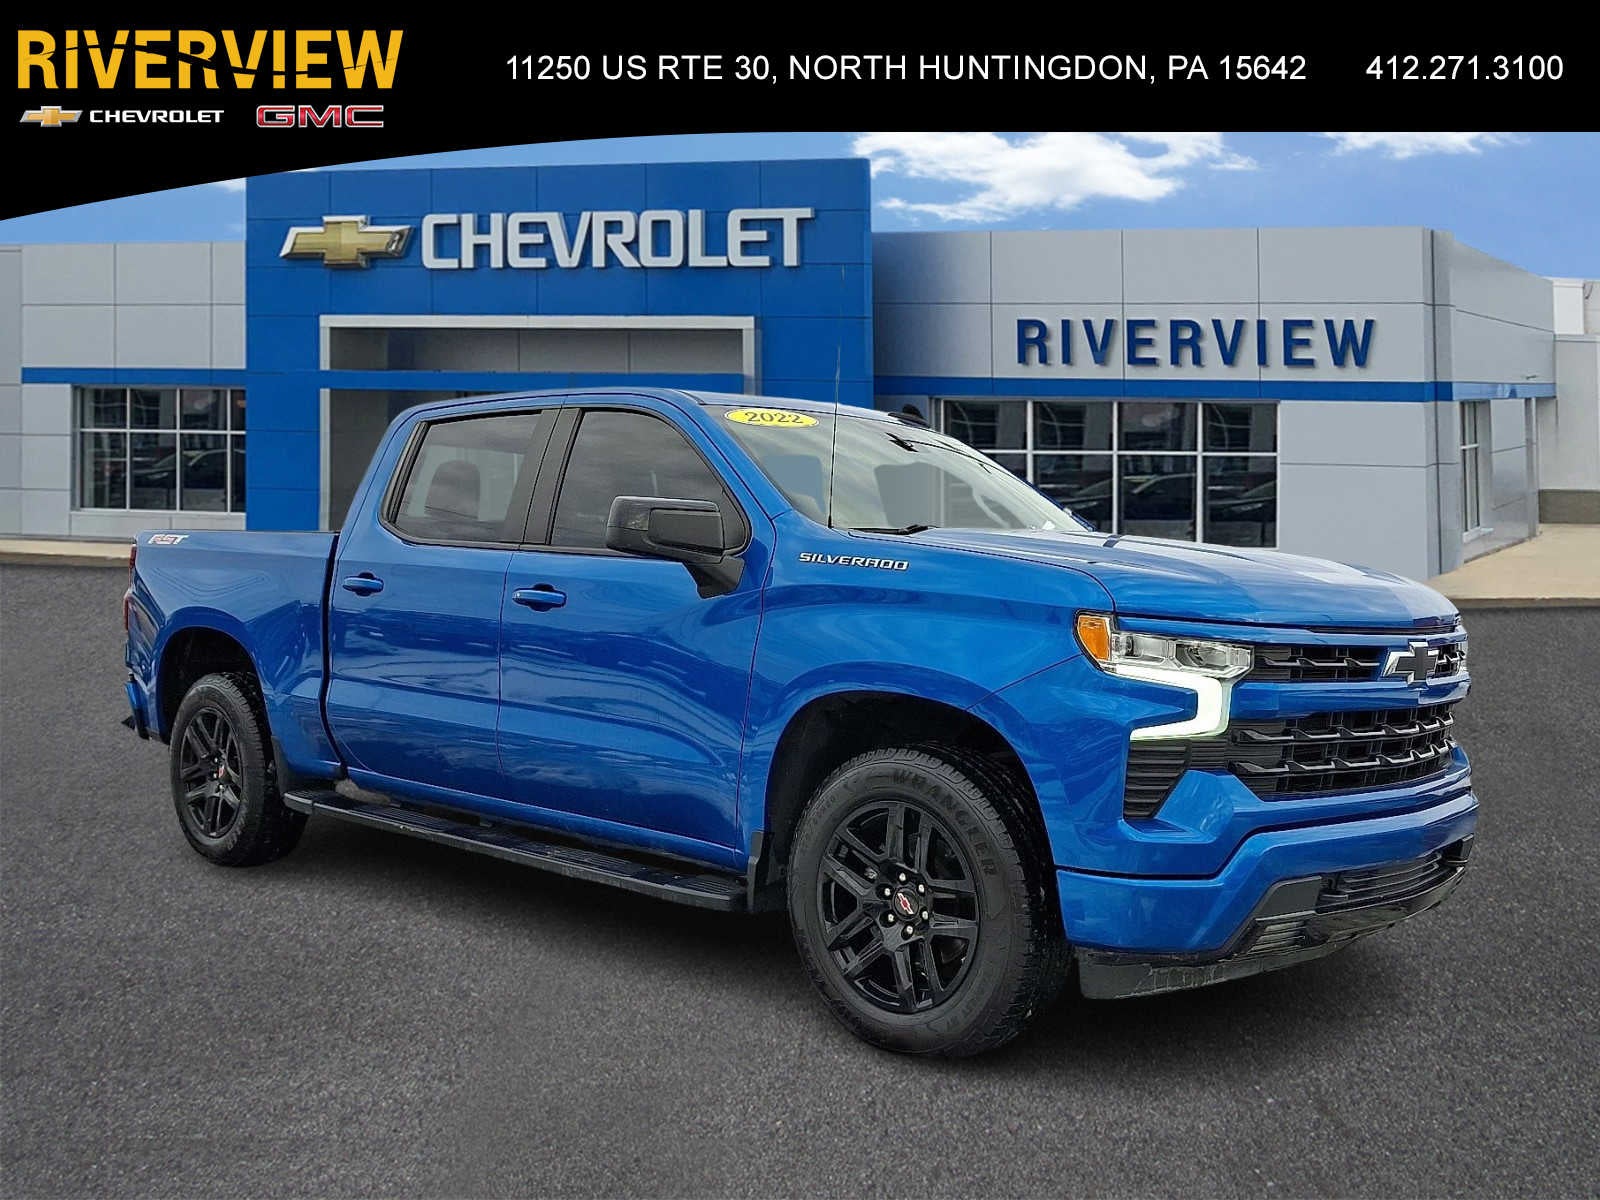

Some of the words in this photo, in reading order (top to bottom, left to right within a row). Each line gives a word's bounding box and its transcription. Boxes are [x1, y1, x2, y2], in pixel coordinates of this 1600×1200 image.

[421, 207, 815, 270] CHEVROLET
[1016, 318, 1376, 368] RIVERVIEW
[744, 411, 804, 424] 2022
[798, 551, 910, 571] SILVERADO
